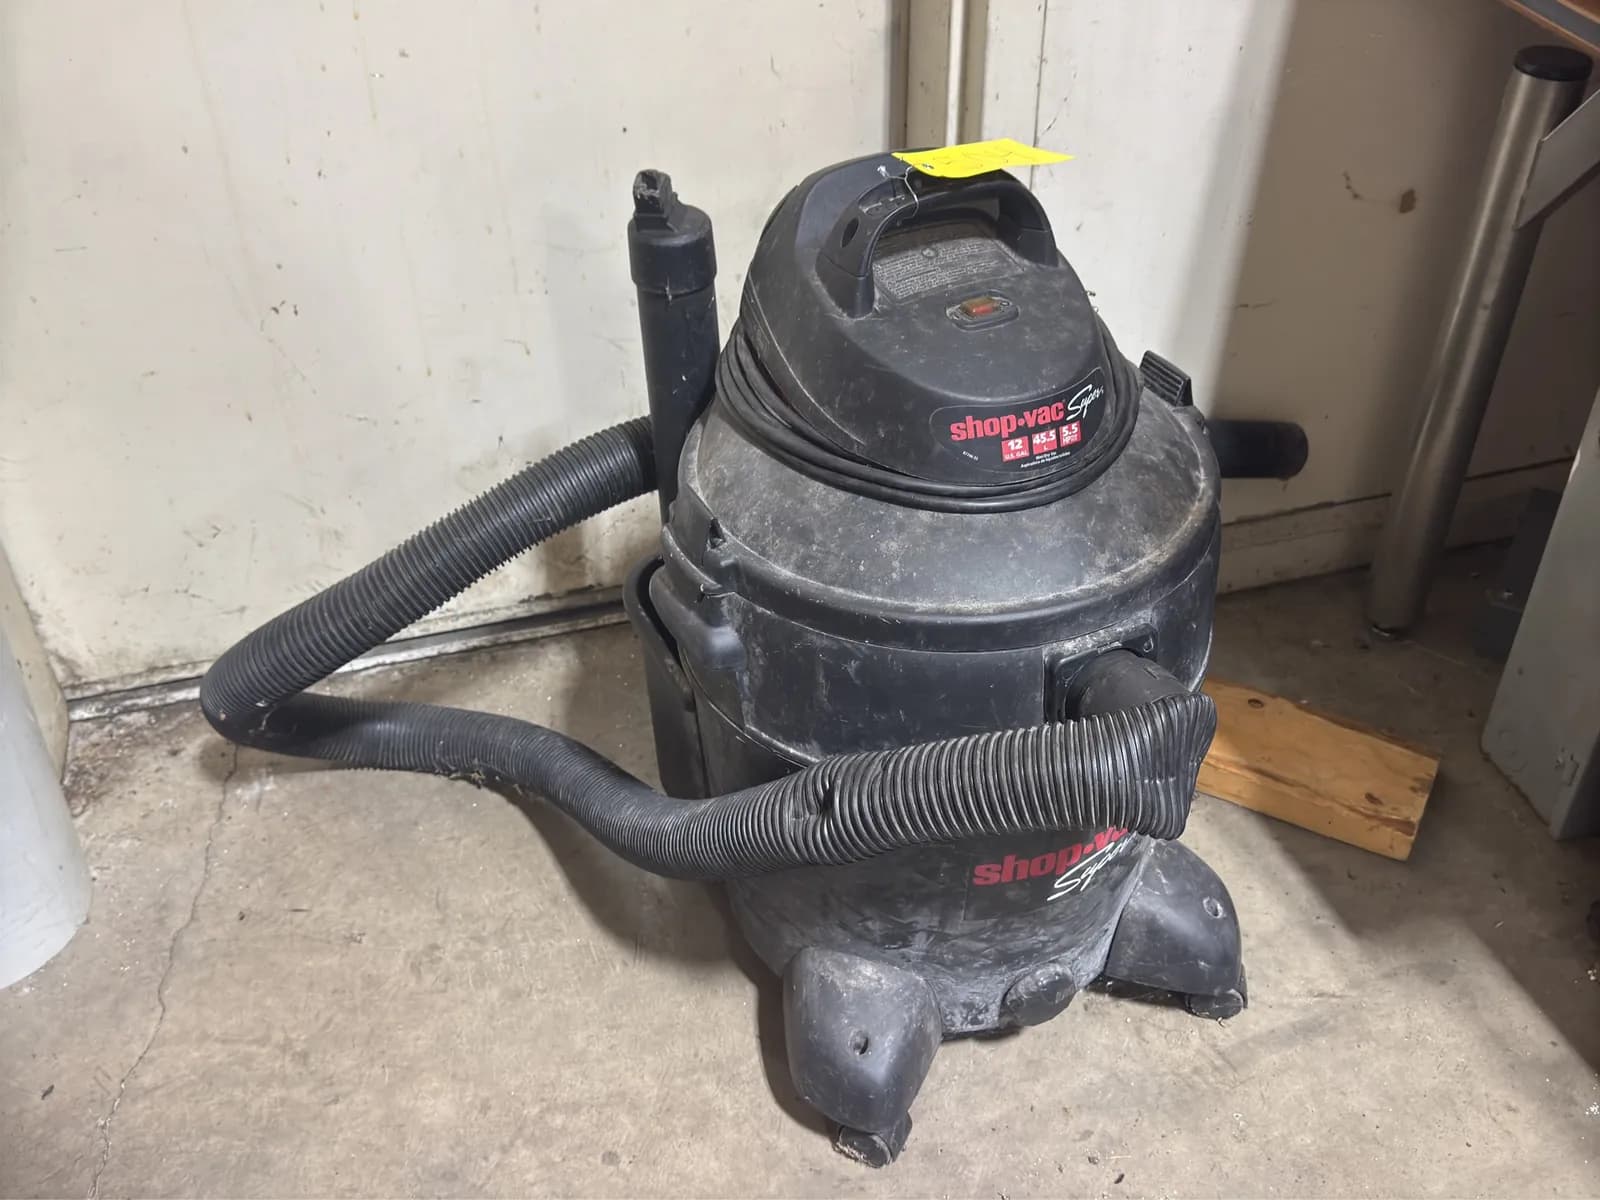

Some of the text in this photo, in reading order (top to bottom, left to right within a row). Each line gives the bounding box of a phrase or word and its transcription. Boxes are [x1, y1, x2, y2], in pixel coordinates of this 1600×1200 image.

[1062, 423, 1078, 437] 5.5
[1008, 438, 1023, 451] 12
[1033, 430, 1056, 445] 45.5
